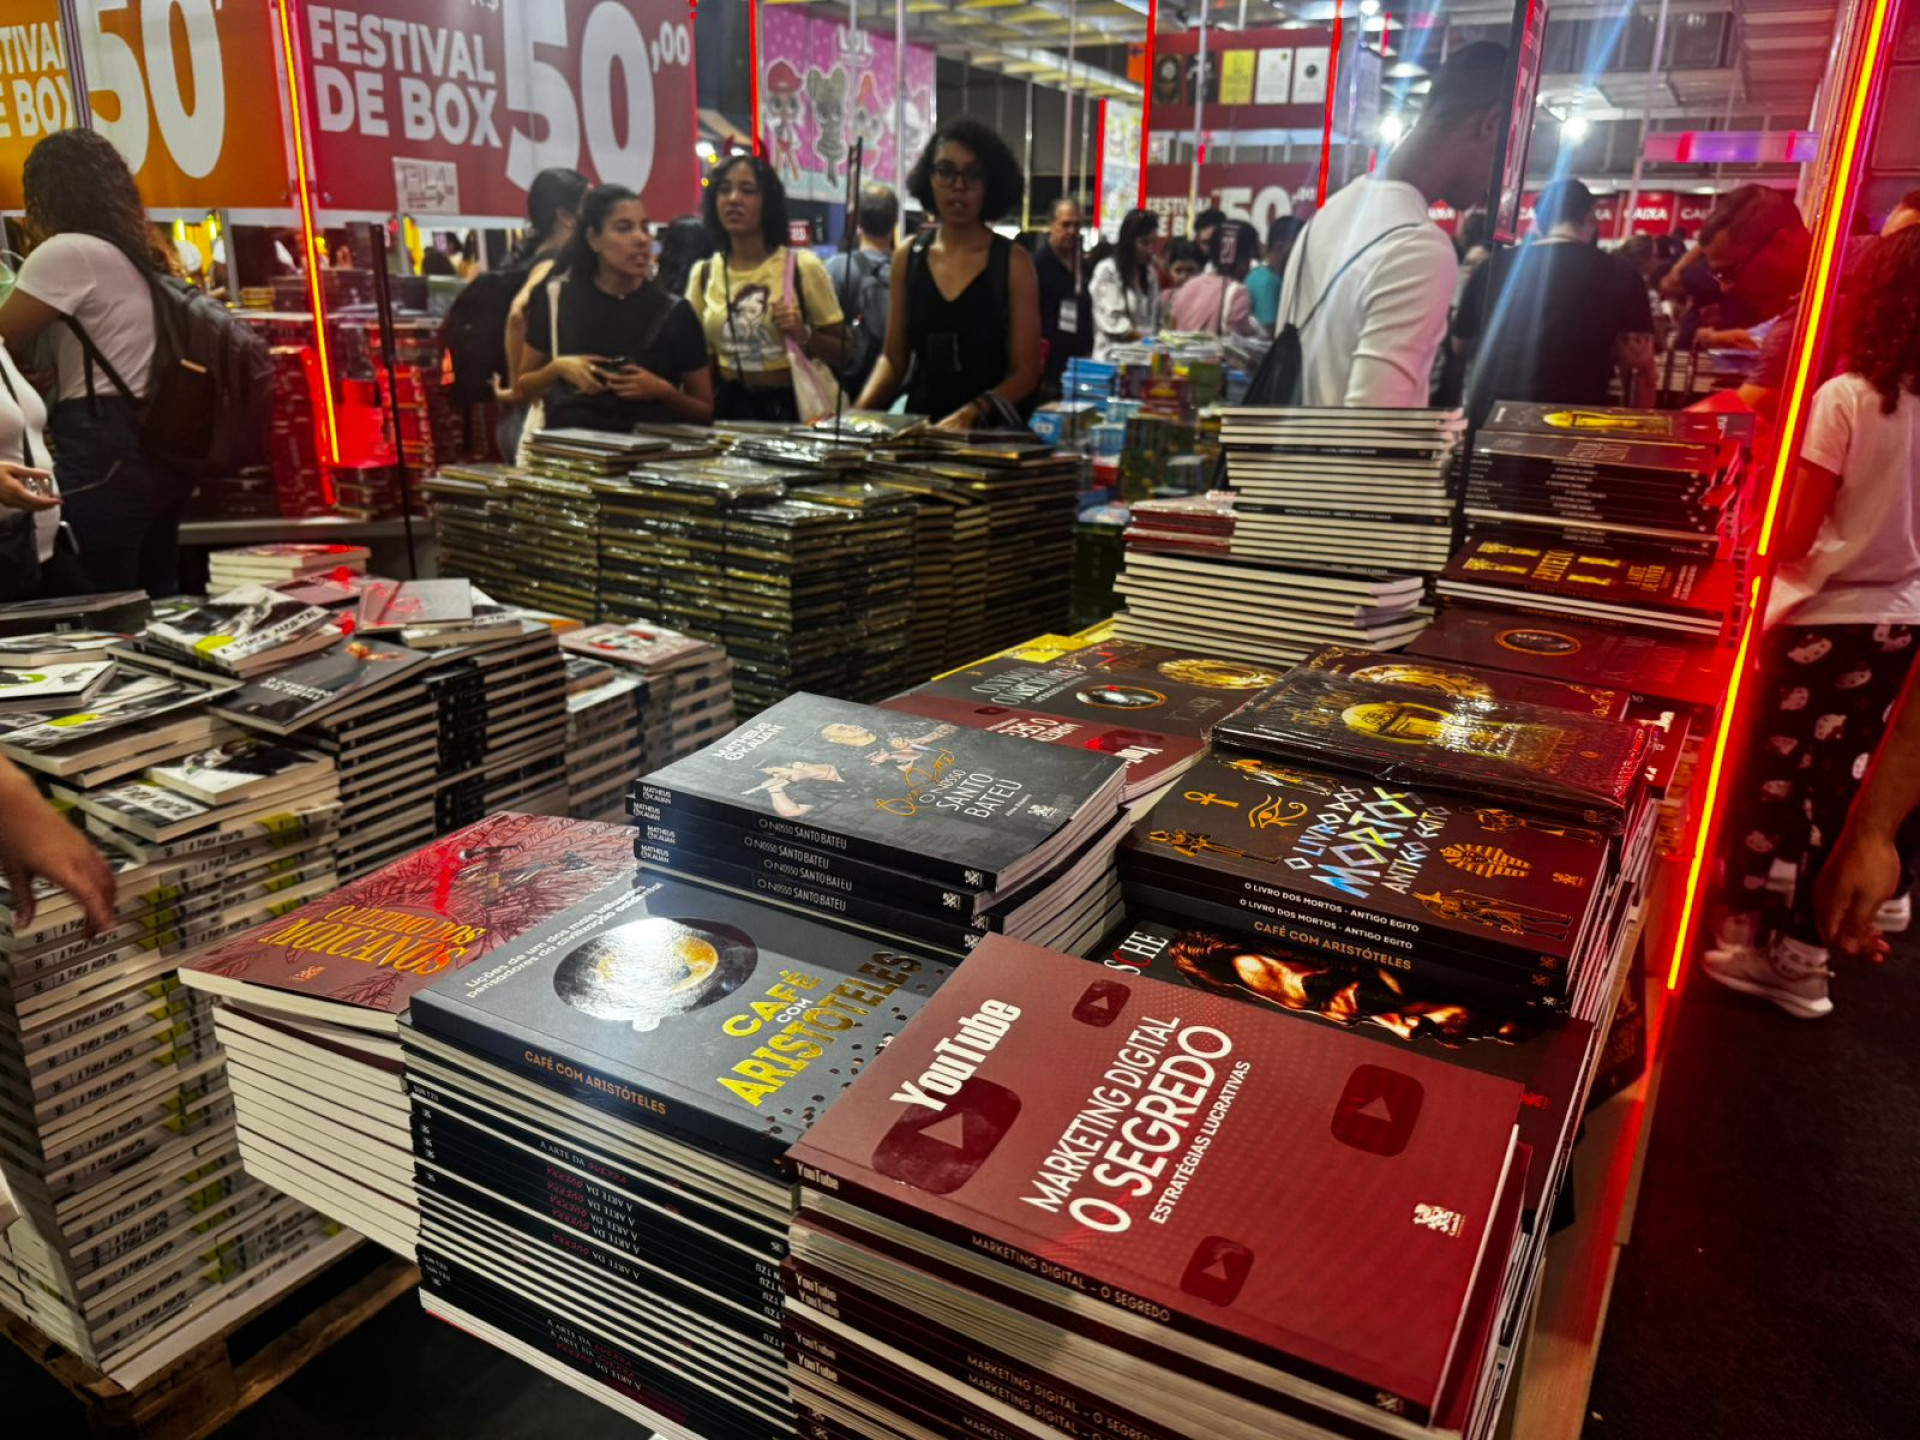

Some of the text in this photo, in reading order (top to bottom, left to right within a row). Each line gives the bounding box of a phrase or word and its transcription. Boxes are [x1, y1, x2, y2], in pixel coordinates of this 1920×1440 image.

[307, 4, 496, 84] FESTIVAL
[313, 65, 503, 148] DE BOX
[712, 722, 771, 757] MATHEUS
[633, 802, 660, 813] MATHEUS
[642, 786, 671, 798] MATHEUS
[919, 769, 967, 803] O NOSSO
[936, 773, 994, 811] SANTO
[964, 779, 1022, 818] BATEU
[641, 844, 669, 856] MATHEUS
[647, 825, 675, 838] MATHEUS
[759, 819, 847, 850] O NOSSO SANTO BATEU
[1284, 785, 1365, 870] O LIVRO DOS
[1310, 787, 1425, 899] MORTOS
[1380, 806, 1452, 895] ANTIGO EGITO
[744, 837, 829, 870] O NOSSO SANTO BATEU
[763, 859, 853, 891] O NOSSO SANTO BATEU
[757, 879, 846, 911] O NOSSO SANTO BATEU
[1253, 884, 1281, 898] LIVRO
[1282, 892, 1301, 903] DOS
[1303, 897, 1343, 913] MORTOS
[1351, 910, 1388, 925] ANTIGO
[1390, 919, 1420, 933] EGITO
[258, 917, 470, 976] MOICANOS
[324, 905, 356, 922] O
[421, 921, 487, 945] DOS
[1239, 899, 1413, 950] O LIVRO DOS MORTOS ANTIGO EGITO
[1254, 921, 1412, 971] CAFÉ COM ARISTÓTELES
[465, 963, 507, 988] Lições
[508, 953, 526, 966] de
[526, 941, 547, 956] um
[547, 929, 569, 943] dos
[466, 956, 539, 999] pensadores
[539, 946, 557, 957] da
[722, 970, 823, 1037] CAFÉ
[776, 997, 813, 1023] COM
[889, 999, 1021, 1111] YouTube
[524, 1050, 667, 1116] CAFÉ COM ARISTÓTELES
[1019, 1016, 1181, 1213] MARKETING DIGITAL
[1068, 1025, 1232, 1233] O SEGREDO
[540, 1141, 546, 1150] A
[548, 1145, 569, 1160] ARTE
[572, 1154, 585, 1167] DA
[1149, 1061, 1251, 1224] ESTRATÉGIAS LUCRATIVAS
[586, 1183, 599, 1195] DA
[602, 1192, 624, 1208] ARTE
[796, 1162, 839, 1191] YouTube
[625, 1202, 634, 1213] A
[972, 1236, 1171, 1322] MARKETING DIGITAL O SEGREDO
[967, 1356, 1103, 1424] MARKETING DIGITAL O
[968, 1374, 1031, 1410] MARKETING
[1034, 1403, 1079, 1434] DIGITAL
